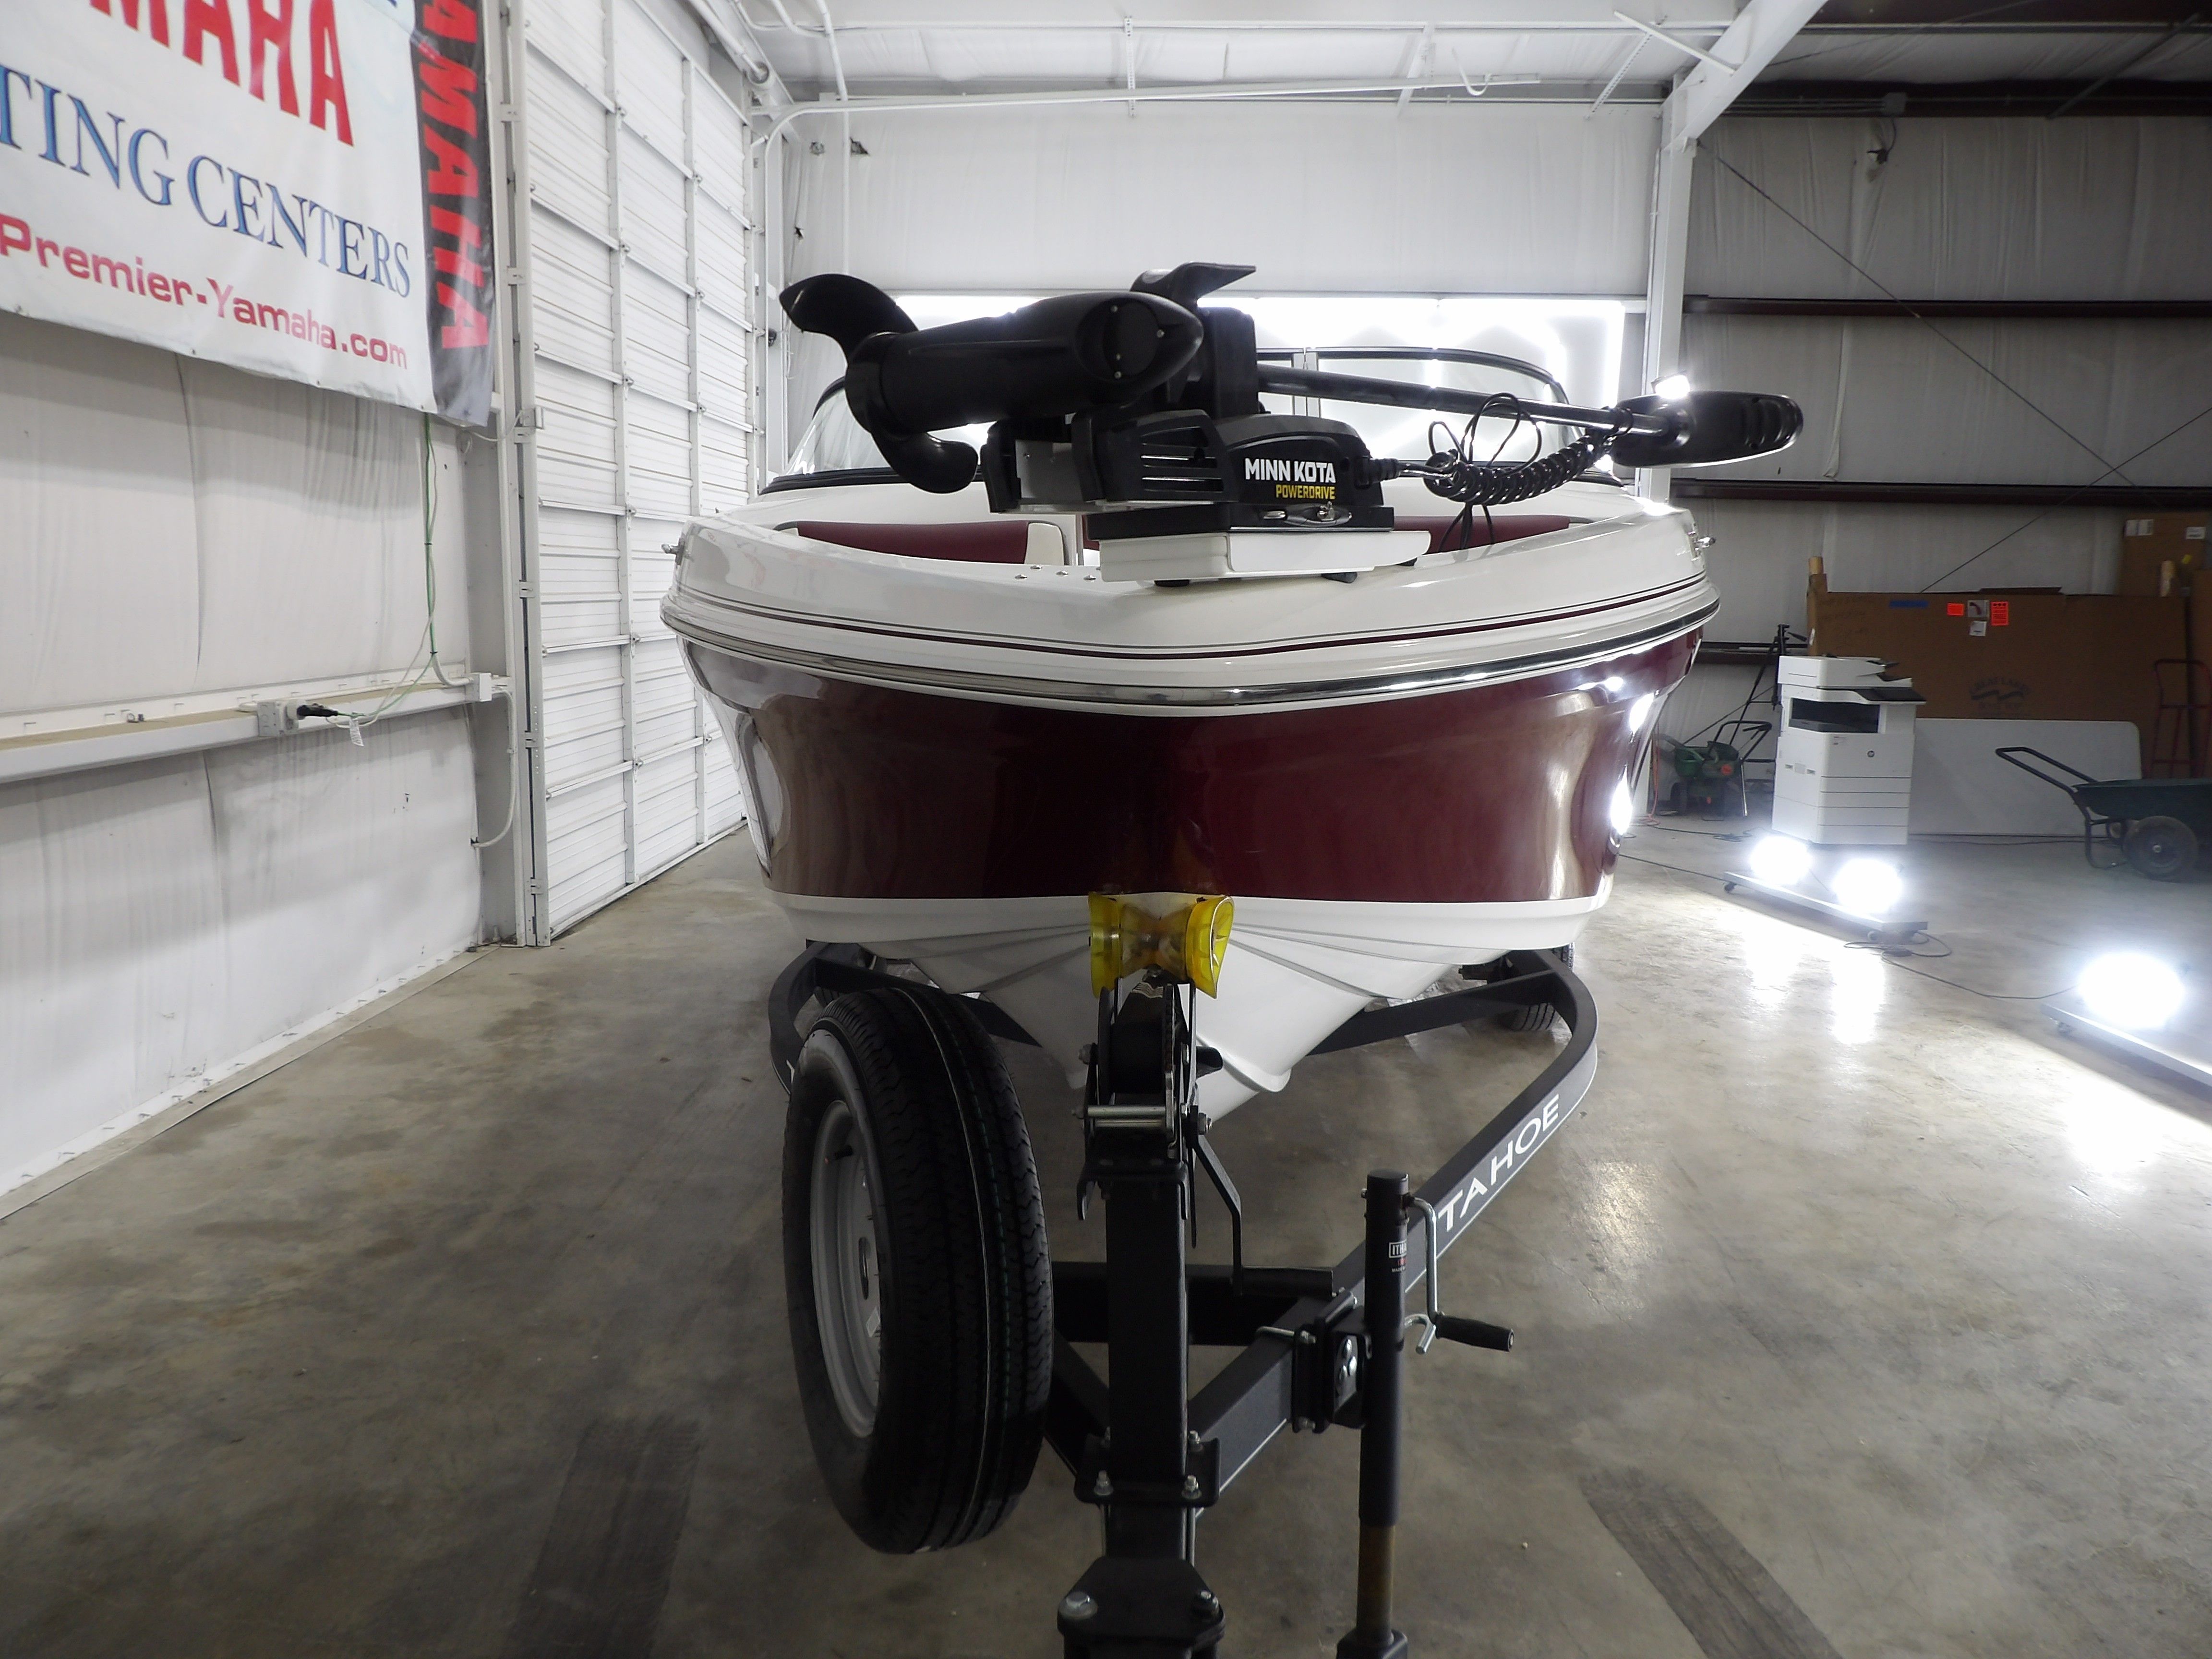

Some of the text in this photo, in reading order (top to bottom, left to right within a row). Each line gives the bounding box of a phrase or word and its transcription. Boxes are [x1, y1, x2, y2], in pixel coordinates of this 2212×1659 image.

[0, 213, 407, 369] Premier-Yamaha.com
[187, 155, 410, 298] CENTERS
[1245, 458, 1336, 483] MINN KOTA
[1275, 484, 1336, 500] POWERDRIVE
[1438, 1094, 1559, 1232] TAHOE
